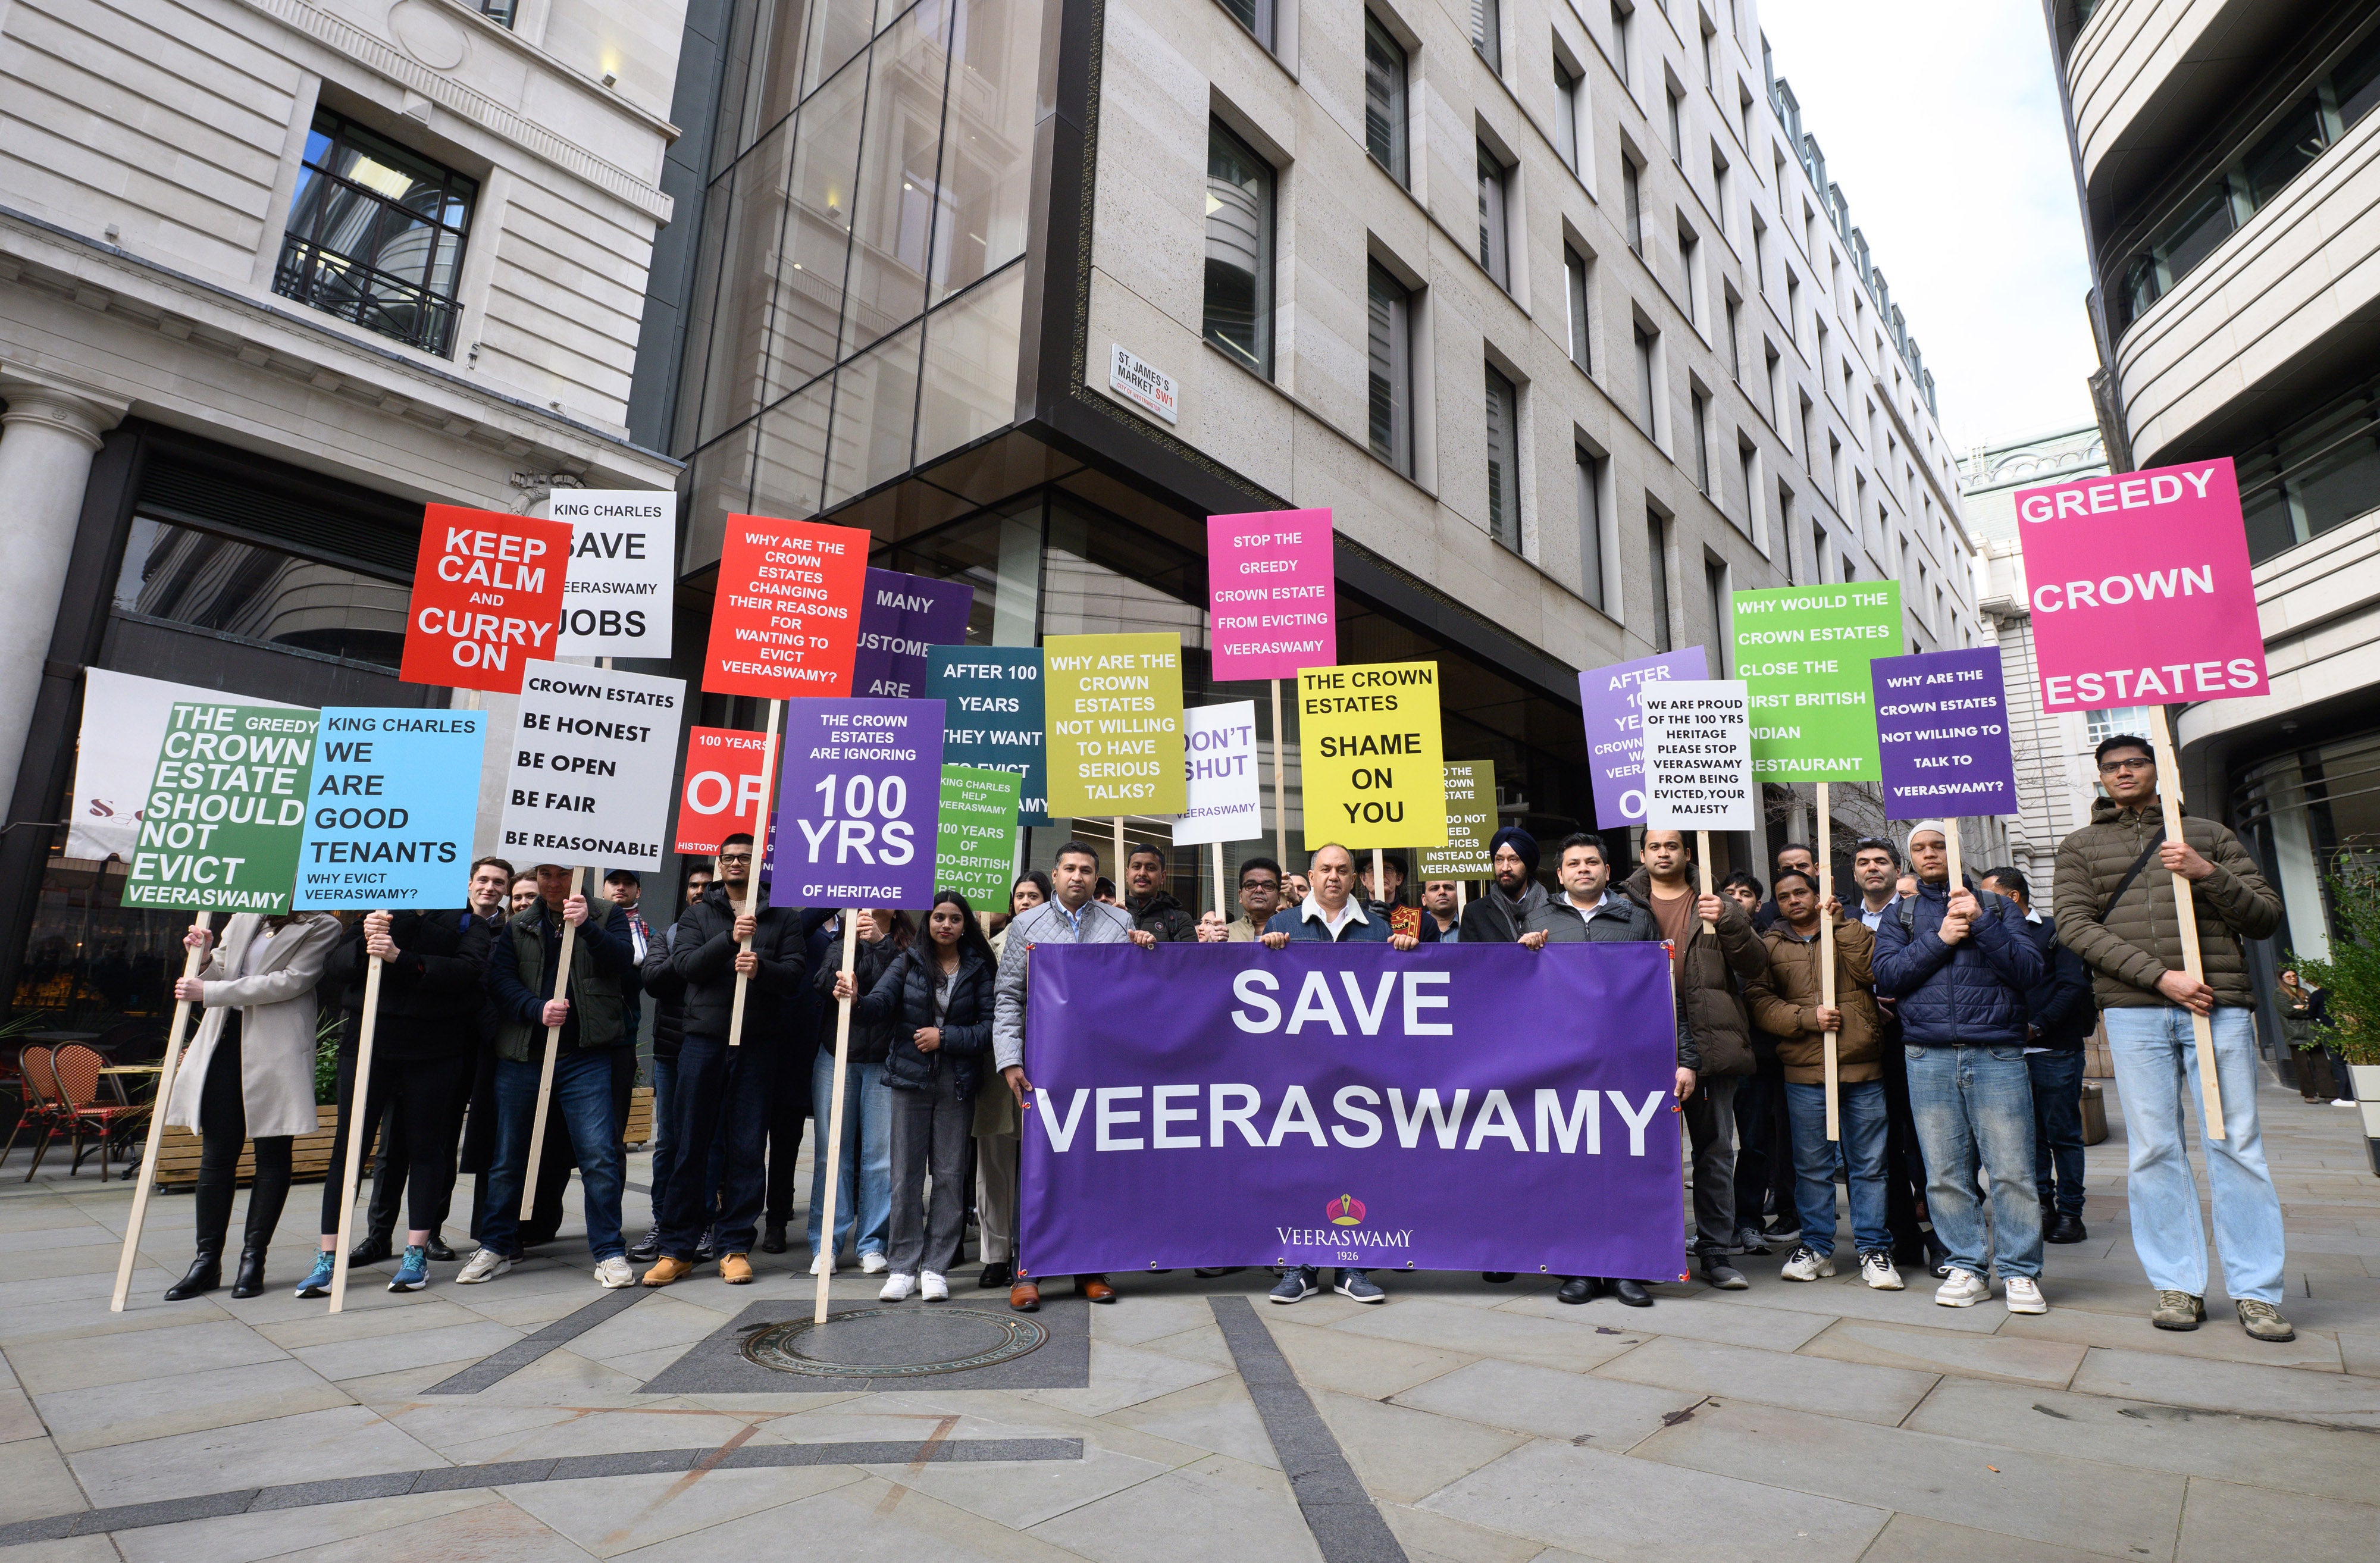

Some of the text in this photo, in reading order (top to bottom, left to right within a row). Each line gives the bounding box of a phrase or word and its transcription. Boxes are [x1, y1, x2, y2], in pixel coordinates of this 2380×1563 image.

[1119, 351, 1169, 391] ST. JAMES'S
[1118, 365, 1173, 408] MARKET SW1
[1117, 382, 1126, 392] CITY
[1133, 391, 1160, 412] WESTMINSTER
[2021, 468, 2215, 523] GREEDY
[555, 505, 661, 517] KING CHARLES
[446, 527, 546, 563] KEEP
[746, 533, 844, 555] WHY ARE THE
[1234, 533, 1302, 547] STOP THE
[765, 551, 821, 567] CROWN
[1240, 560, 1298, 574] GREEDY
[438, 555, 545, 593] CALM
[759, 566, 822, 583] ESTATES
[749, 581, 827, 600] CHANGING
[1216, 585, 1324, 602] CROWN ESTATE
[2034, 565, 2213, 612] CROWN
[469, 592, 503, 606] AND
[729, 595, 847, 619] THEIR REASONS
[877, 590, 934, 613] MANY
[1737, 593, 1888, 614] WHY WOULD THE
[419, 607, 552, 647] CURRY
[558, 609, 646, 637] JOBS
[771, 616, 801, 629] FOR
[1219, 613, 1327, 628] FROM EVICTING
[736, 628, 828, 649] WANTING TO
[1739, 625, 1889, 645] CROWN ESTATES
[453, 641, 508, 671] ON
[760, 648, 804, 662] EVICT
[1224, 640, 1323, 655] VEERASWAMY
[722, 660, 837, 682] VEERASWAMY?
[1051, 654, 1176, 671] WHY ARE THE
[1740, 660, 1838, 676] CLOSE THE
[944, 664, 1036, 679] AFTER 100
[1304, 669, 1432, 690] THE CROWN
[1609, 665, 1671, 691] AFTER
[1887, 670, 1983, 688] WHY ARE THE
[869, 679, 910, 697] ARE
[1079, 676, 1148, 691] CROWN
[2046, 659, 2258, 704] ESTATES
[529, 678, 674, 708] CROWN ESTATES
[1795, 692, 1865, 706] BRITISH
[959, 697, 1019, 712] YEARS
[1075, 697, 1155, 713] ESTATES
[1306, 696, 1398, 714] ESTATES
[1648, 700, 1742, 709] WE ARE PROUD
[1880, 697, 1997, 716] CROWN ESTATES
[174, 706, 320, 734] THE GREEDY
[328, 718, 475, 733] KING CHARLES
[524, 713, 650, 742] BE HONEST
[821, 715, 907, 727] THE CROWN
[1056, 718, 1175, 735] NOT WILLING
[1648, 716, 1664, 724] OF
[1668, 715, 1690, 723] THE
[1695, 715, 1716, 723] 100
[1720, 715, 1743, 723] YRS
[700, 735, 721, 746] 100
[831, 731, 894, 743] ESTATES
[990, 731, 1042, 746] WANT
[1667, 730, 1726, 738] HERITAGE
[1881, 725, 2001, 743] NOT WILLING TO
[165, 732, 311, 765] CROWN
[325, 743, 372, 762] WE
[1076, 740, 1155, 756] TO HAVE
[1320, 733, 1421, 757] SHAME
[1595, 737, 1643, 754] CROWN
[1658, 745, 1736, 753] PLEASE STOP
[810, 748, 916, 760] ARE IGNORING
[1914, 755, 1972, 768] TALK TO
[518, 751, 616, 776] BE OPEN
[1079, 762, 1160, 778] SERIOUS
[1185, 754, 1248, 781] SHUT
[1451, 767, 1472, 775] THE
[1654, 760, 1742, 768] VEERASWAMY
[156, 761, 297, 794] ESTATE
[318, 775, 384, 795] ARE
[1352, 768, 1392, 790] ON
[1659, 775, 1739, 783] FROM BEING
[966, 781, 1010, 793] CHARLES
[1085, 783, 1155, 799] TALKS?
[1893, 781, 2003, 797] VEERASWAMY?
[512, 790, 595, 813] BE FAIR
[816, 774, 906, 819] 100
[962, 791, 987, 801] HELP
[148, 792, 303, 825] SHOULD
[940, 800, 1007, 815] VEERASWAMY
[1343, 801, 1403, 823] YOU
[1672, 805, 1728, 813] MAJESTY
[315, 808, 408, 829] GOOD
[1465, 815, 1486, 823] NOT
[140, 821, 218, 849] NOT
[962, 825, 1004, 838] YEARS
[505, 831, 658, 857] BE REASONABLE
[678, 842, 719, 851] HISTORY
[797, 819, 914, 865] YRS
[960, 841, 978, 851] OF
[311, 842, 456, 863] TENANTS
[1427, 851, 1473, 860] INSTEAD
[131, 853, 245, 884] EVICT
[308, 873, 387, 884] WHY EVICT
[985, 873, 1002, 884] TO
[130, 885, 286, 909] VEERASWAMY
[305, 889, 418, 899] VEERASWAMY?
[803, 885, 901, 898] OF HERITAGE
[960, 887, 994, 899] LOST
[1232, 969, 1454, 1035] SAVE
[1035, 1083, 1667, 1157] VEERASWAMY
[1276, 1227, 1414, 1248] VEERASWAMY
[1336, 1251, 1358, 1261] 1926
